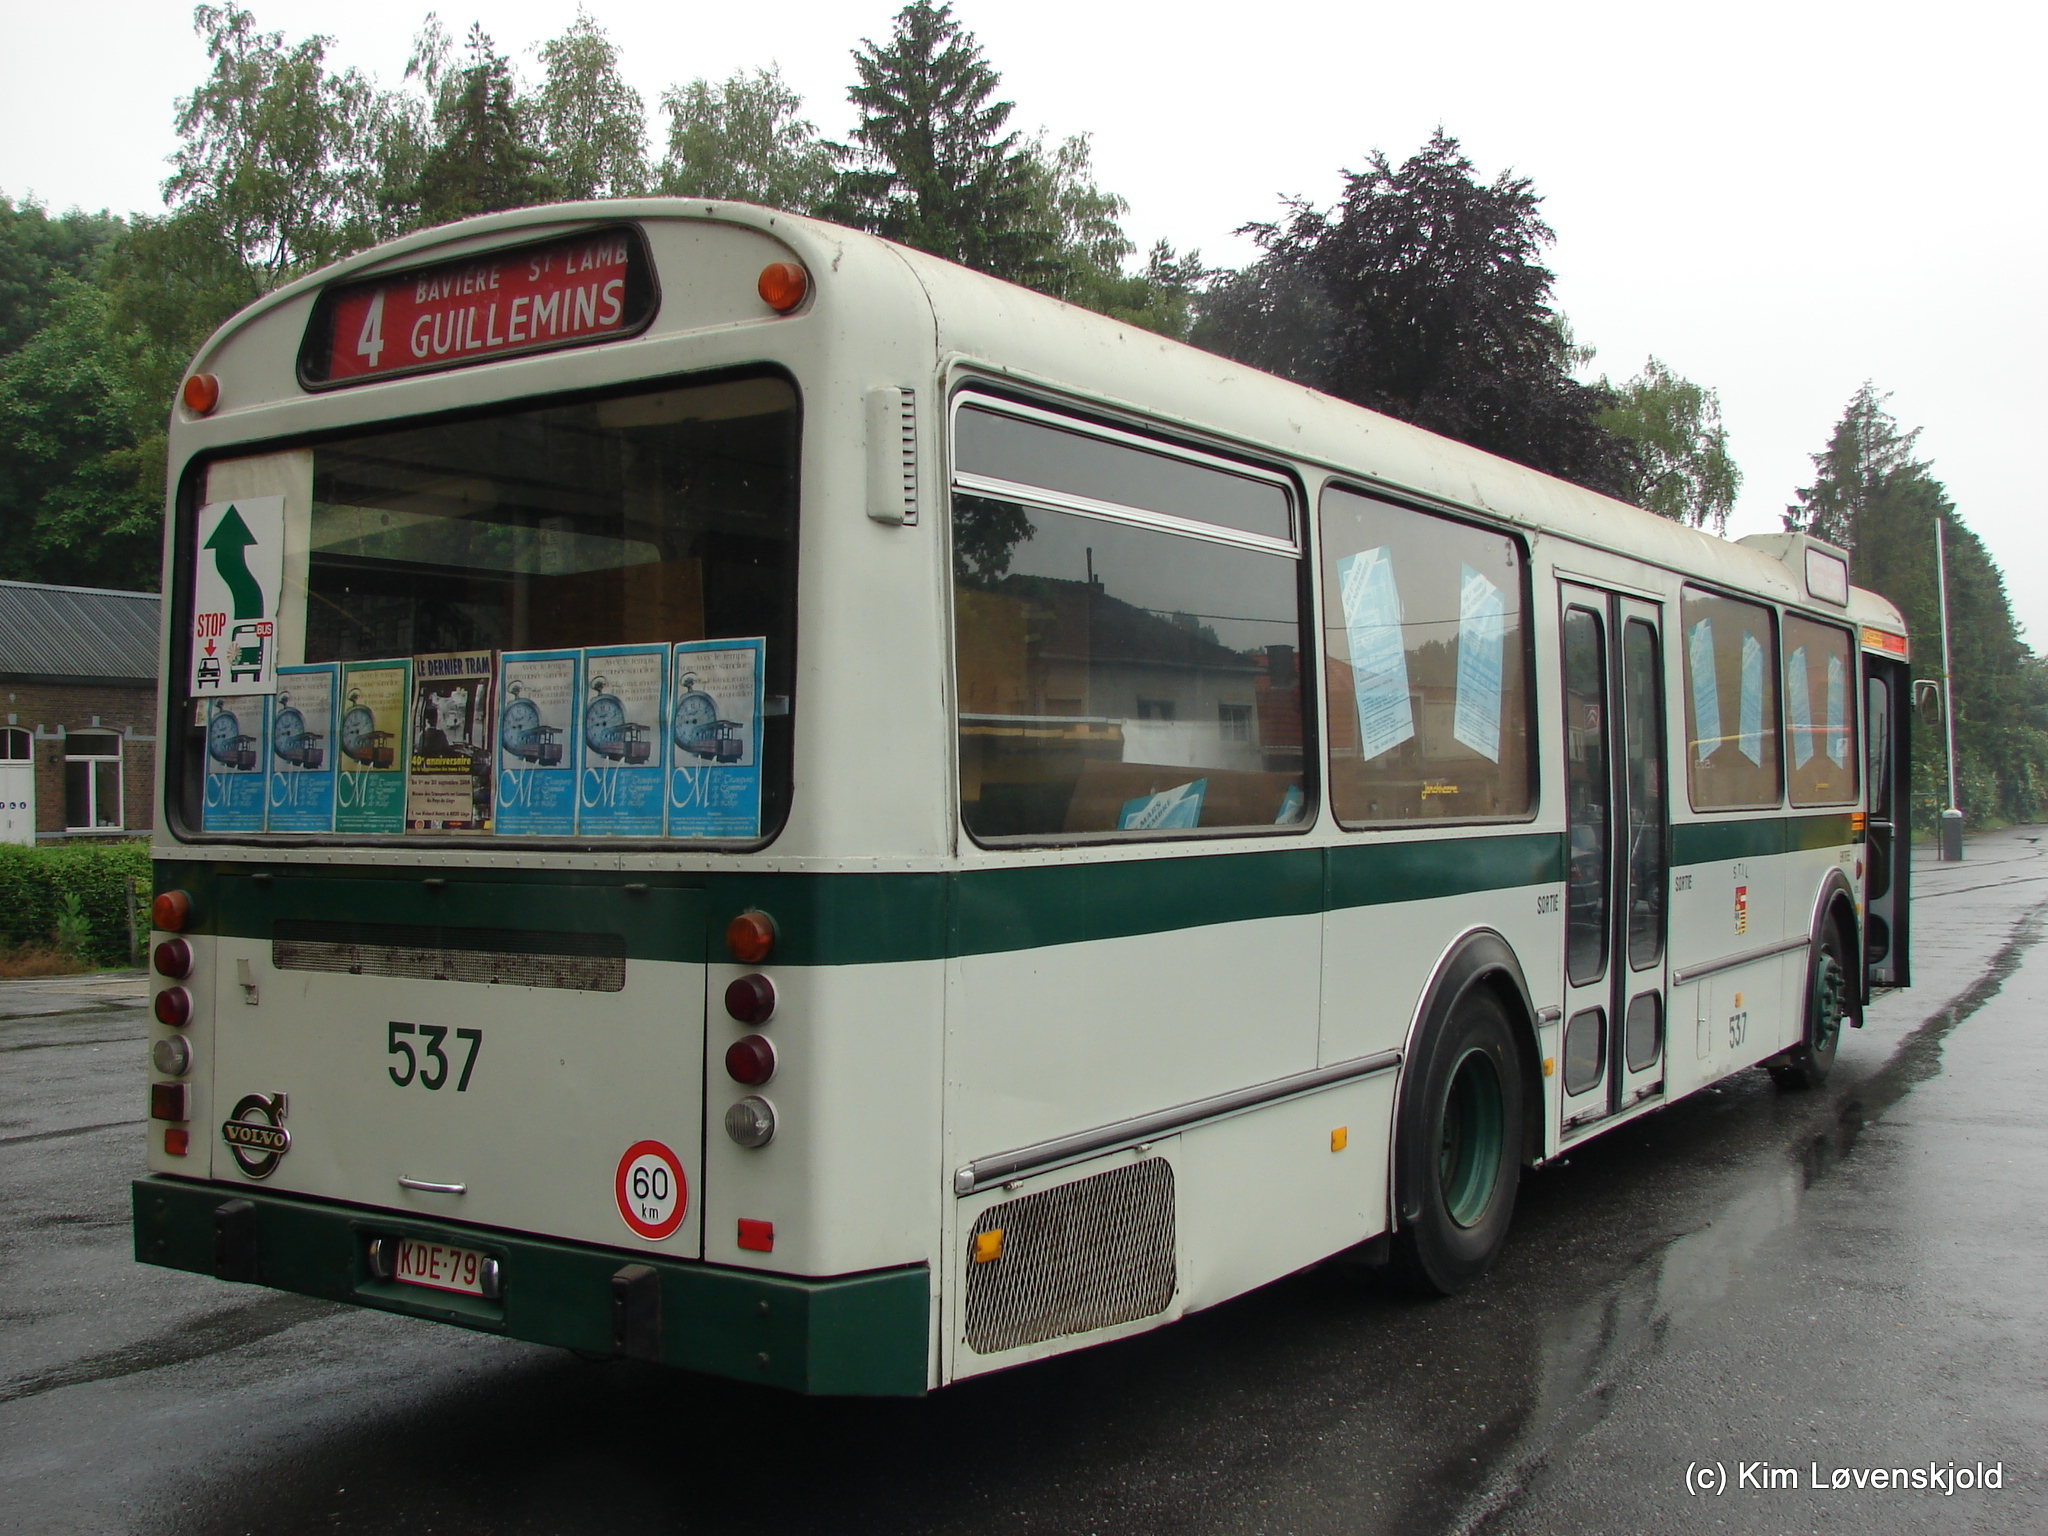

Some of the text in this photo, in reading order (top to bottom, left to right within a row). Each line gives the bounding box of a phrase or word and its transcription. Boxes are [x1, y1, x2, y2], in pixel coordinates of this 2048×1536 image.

[357, 278, 624, 368] 4 GUILLEMINS
[197, 612, 227, 638] STOP
[256, 623, 272, 635] BUS
[417, 656, 490, 677] LE DERNIER TRAM
[426, 754, 471, 766] anniversaire
[1139, 800, 1162, 828] MARS
[1675, 874, 1692, 892] SORTIE
[1537, 893, 1559, 914] SORTIE
[1729, 1011, 1747, 1049] 537
[388, 1021, 483, 1092] 537
[226, 1125, 285, 1147] VOLVO
[633, 1166, 668, 1201] 60
[641, 1202, 659, 1220] km
